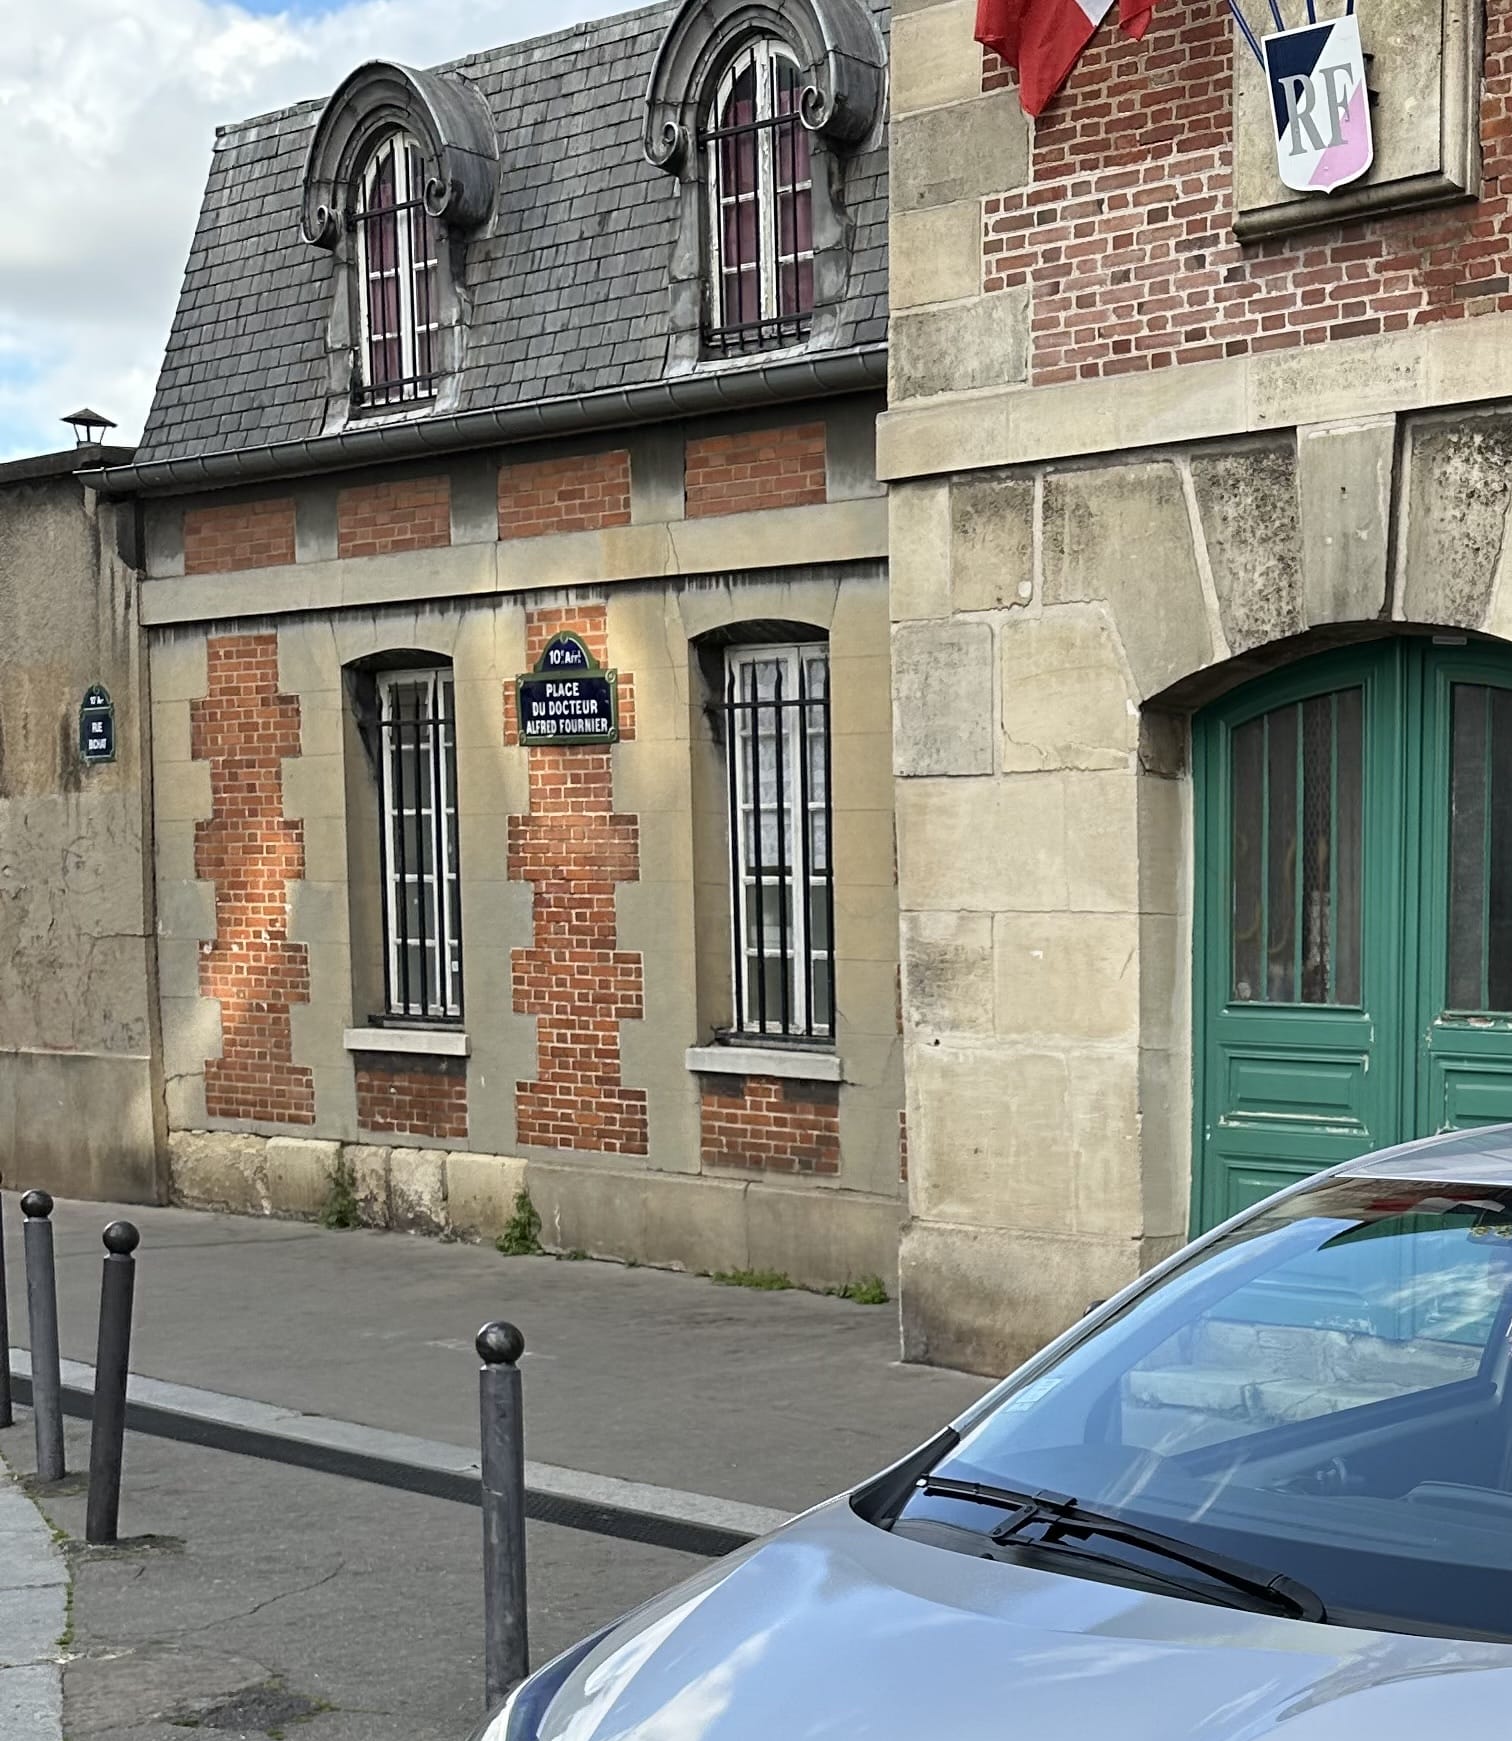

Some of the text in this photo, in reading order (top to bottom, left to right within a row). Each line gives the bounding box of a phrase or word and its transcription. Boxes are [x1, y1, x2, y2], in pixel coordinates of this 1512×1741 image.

[1278, 63, 1354, 156] RF
[546, 682, 580, 697] PLACE
[532, 700, 598, 716] DU DOCTEUR
[526, 718, 608, 735] ALFRED FOURNIER
